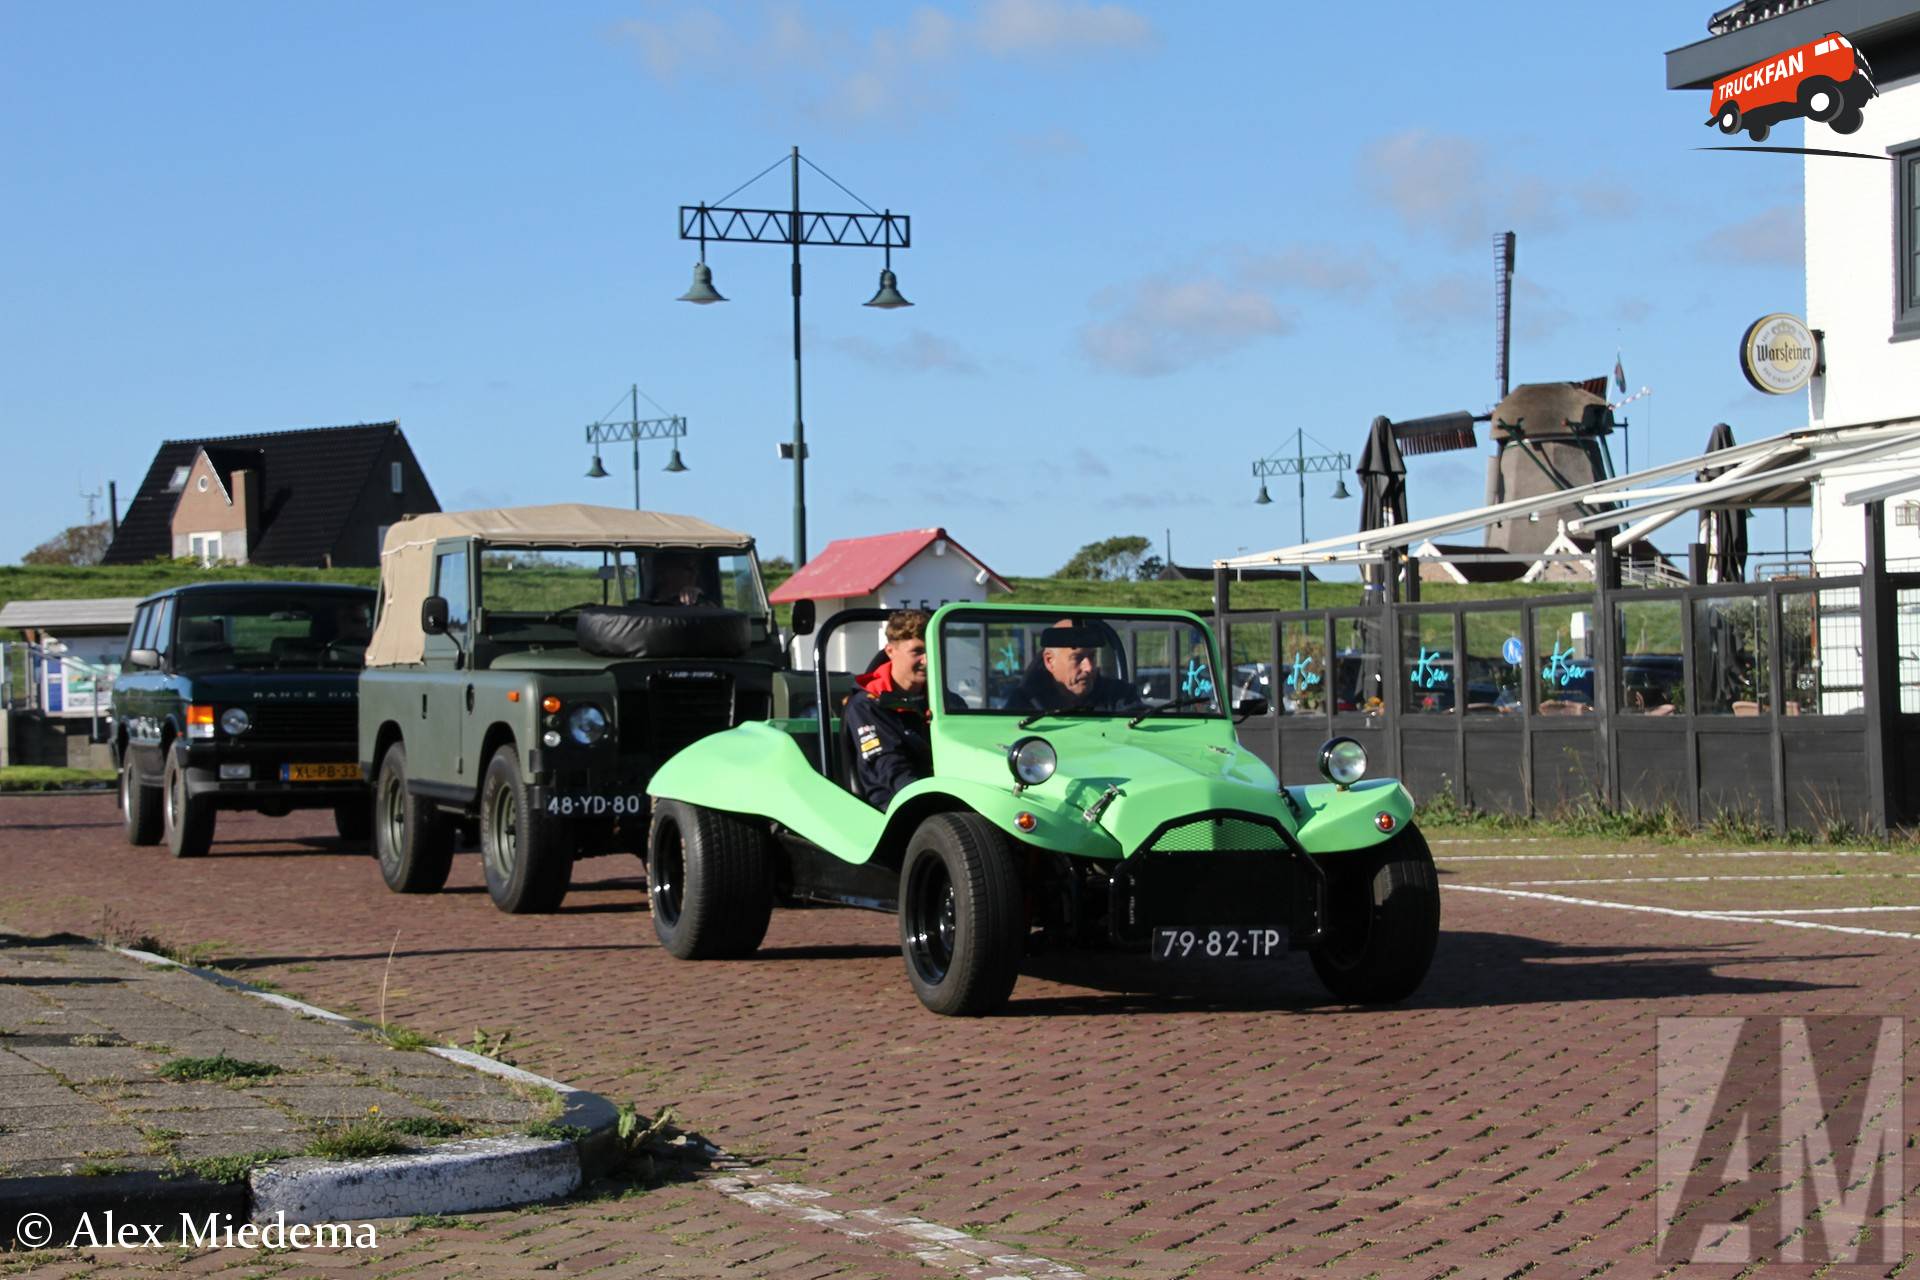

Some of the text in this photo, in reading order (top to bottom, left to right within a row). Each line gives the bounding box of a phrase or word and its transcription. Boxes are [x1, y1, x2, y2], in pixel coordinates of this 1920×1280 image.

[1756, 341, 1811, 362] Warsteiner
[548, 795, 639, 814] 48-YD-80
[1161, 930, 1280, 957] 79-82-TP
